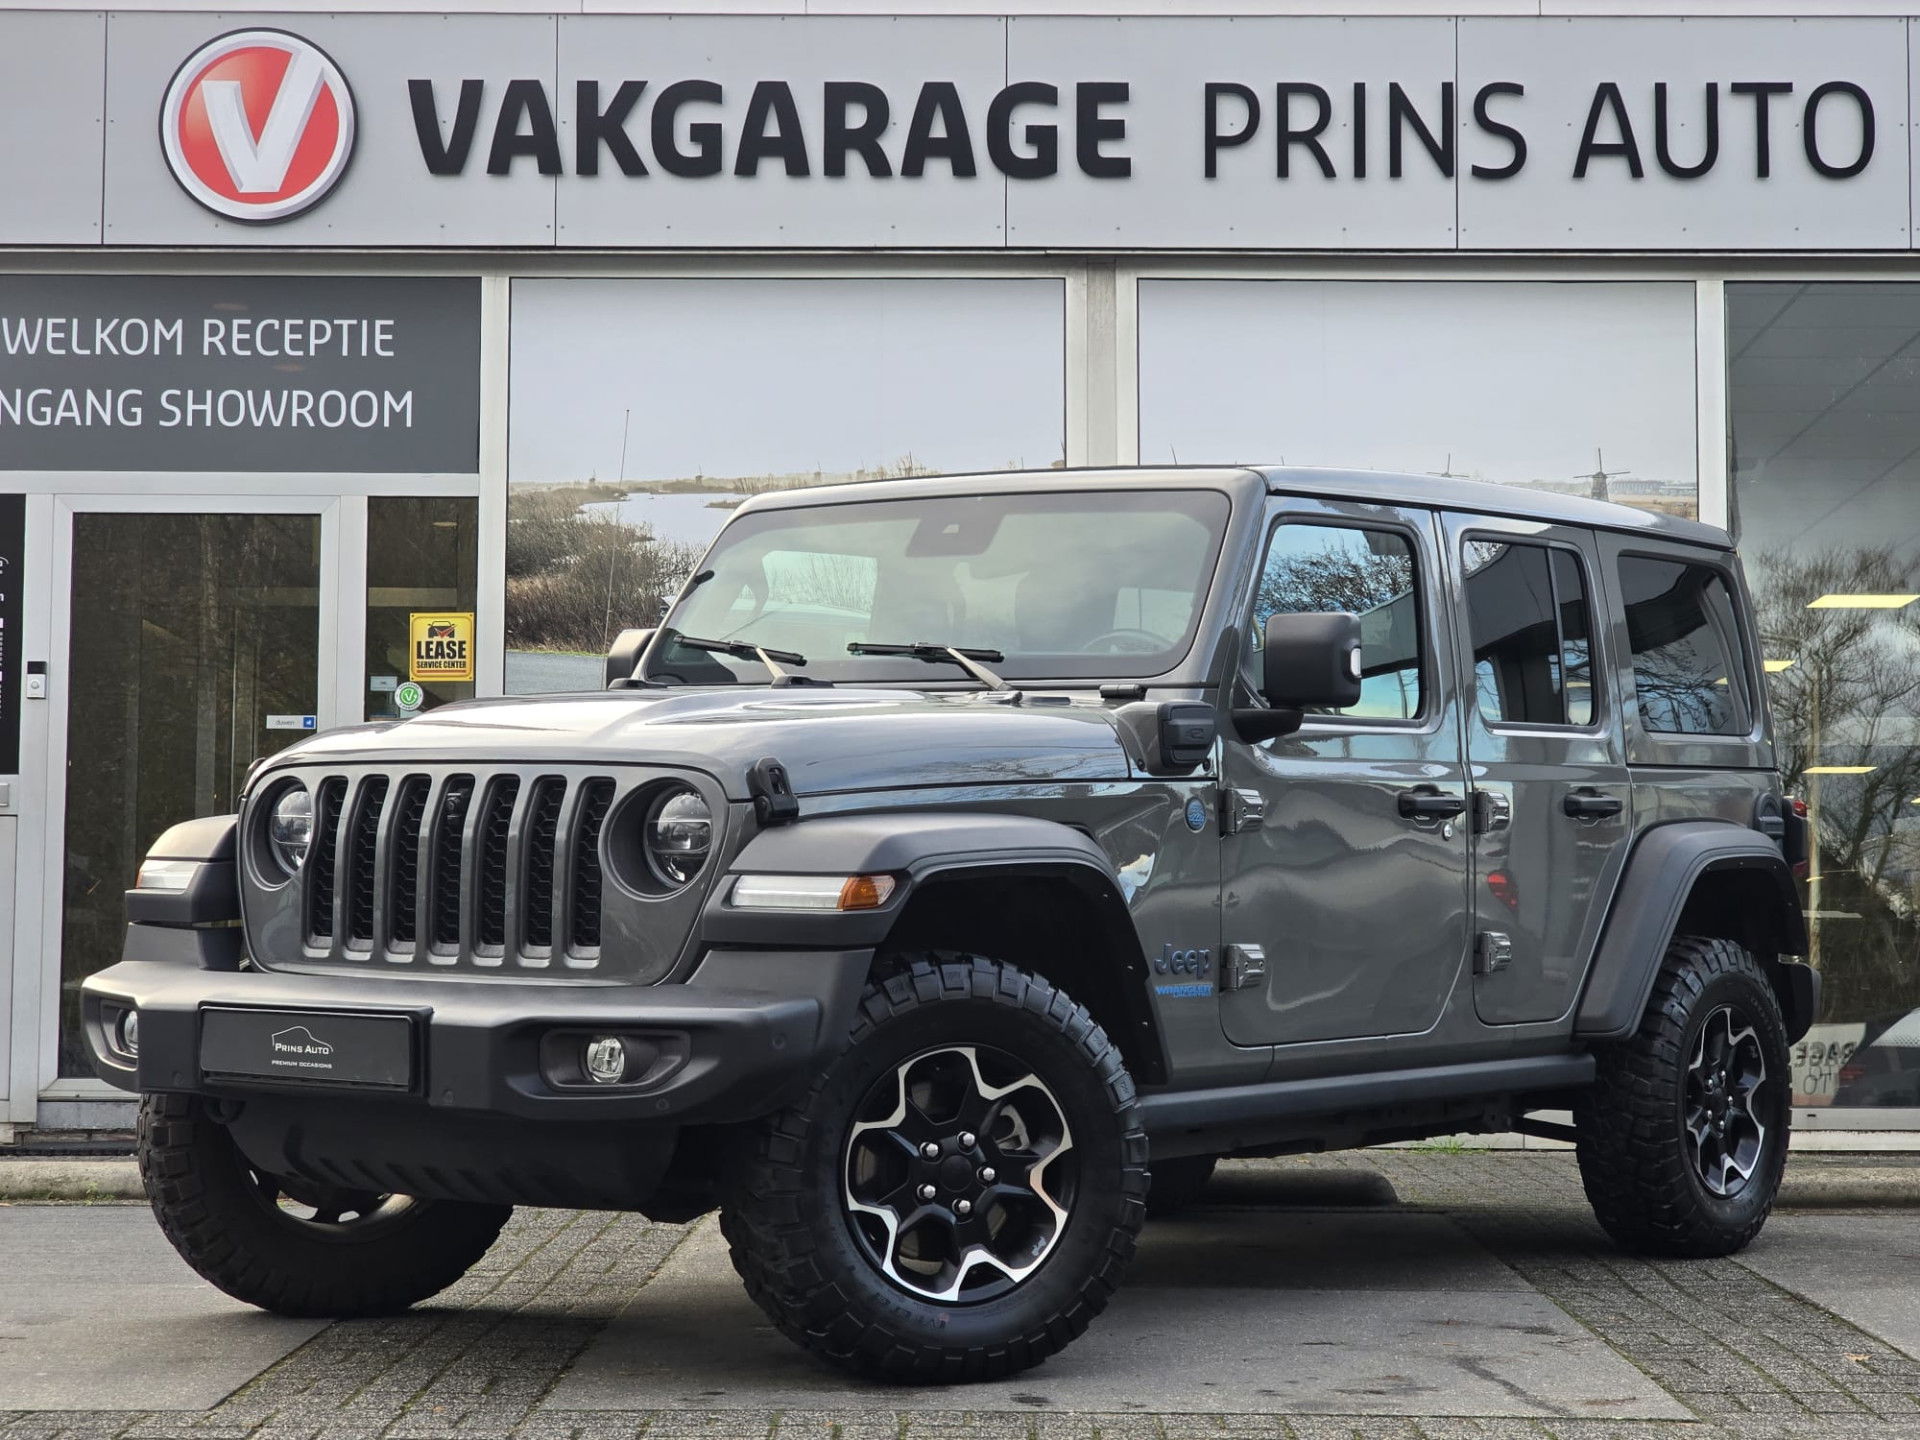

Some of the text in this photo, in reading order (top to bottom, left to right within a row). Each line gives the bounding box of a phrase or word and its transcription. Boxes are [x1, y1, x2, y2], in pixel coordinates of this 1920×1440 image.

[408, 79, 1876, 181] VAKGARAGE PRINS AUTO
[1, 317, 395, 357] WELKOM RECEPTIE
[159, 389, 413, 428] SHOWROOM
[416, 640, 467, 660] LEASE
[416, 660, 467, 669] SERVICE CENTER
[1154, 943, 1211, 980] Jeep
[275, 1042, 330, 1055] PRINS AUTO
[298, 1061, 333, 1069] OCCASIONS
